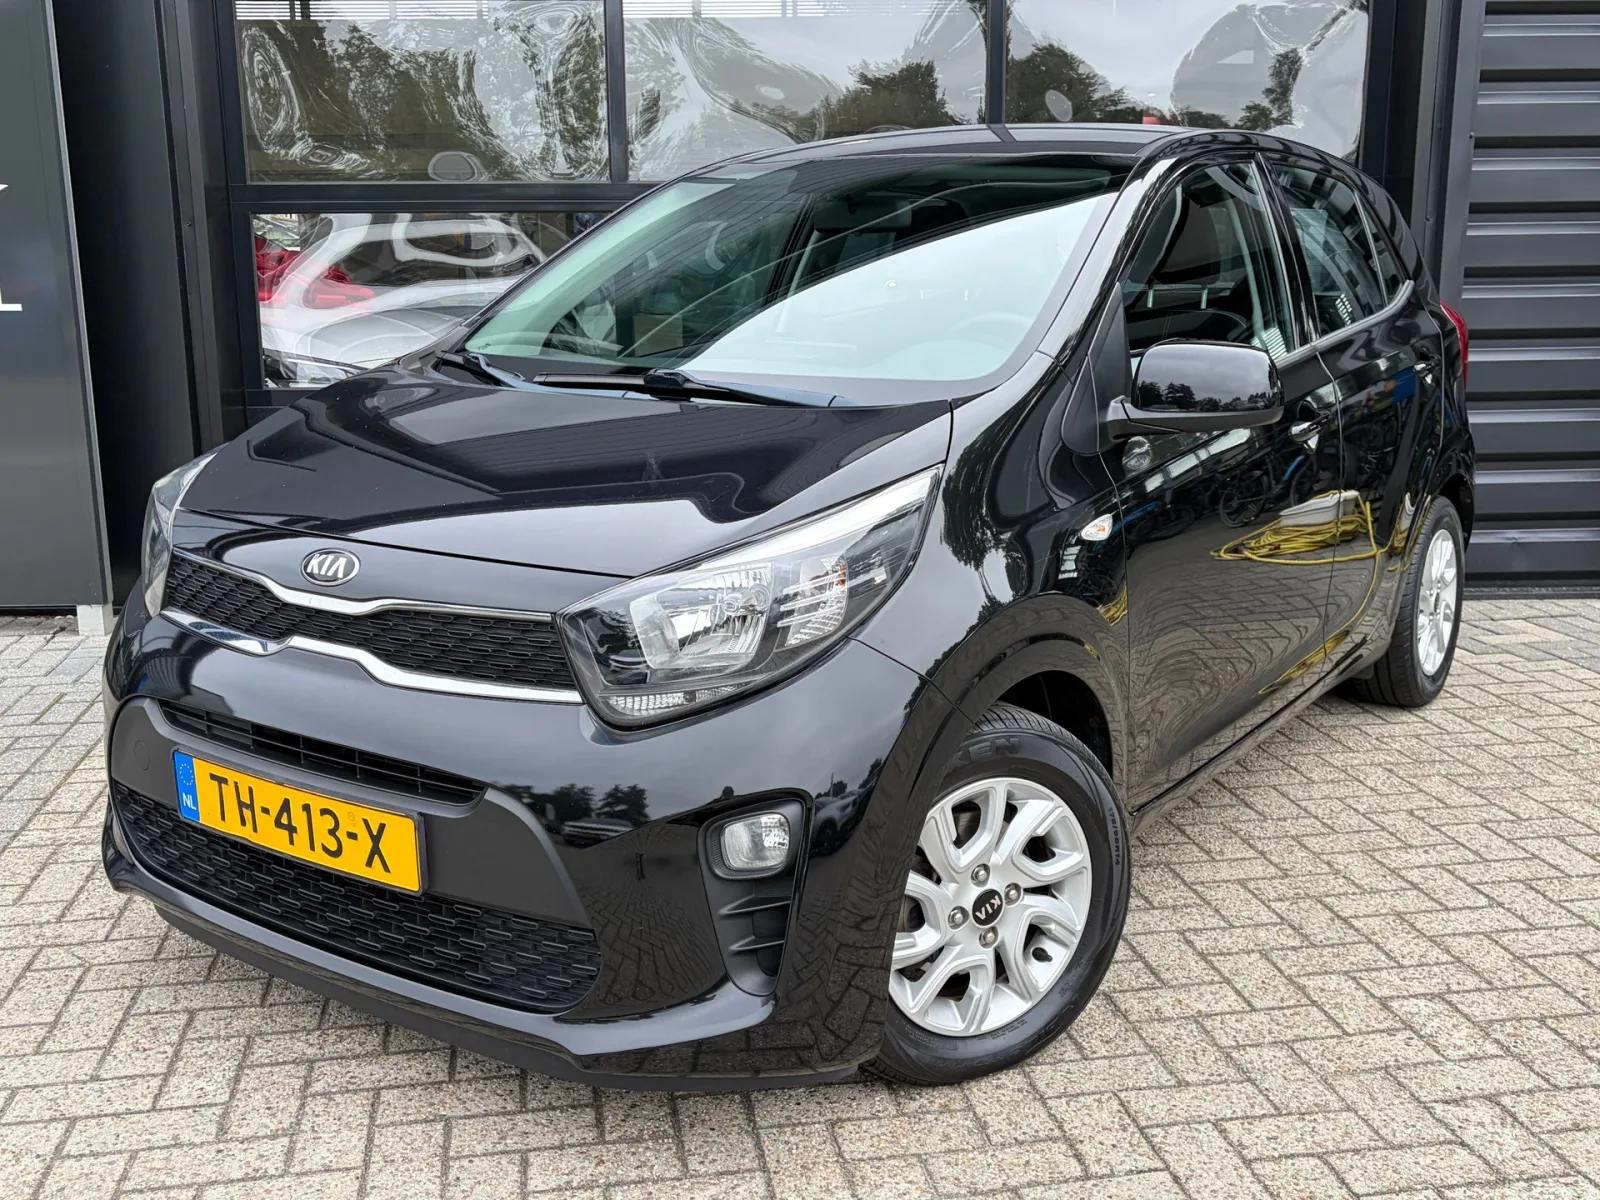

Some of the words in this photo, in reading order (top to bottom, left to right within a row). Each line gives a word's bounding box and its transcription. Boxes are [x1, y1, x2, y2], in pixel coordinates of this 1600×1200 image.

[306, 553, 348, 579] KIA
[182, 792, 197, 811] NL
[209, 773, 391, 874] TH-413-X
[975, 894, 1001, 920] KIA
